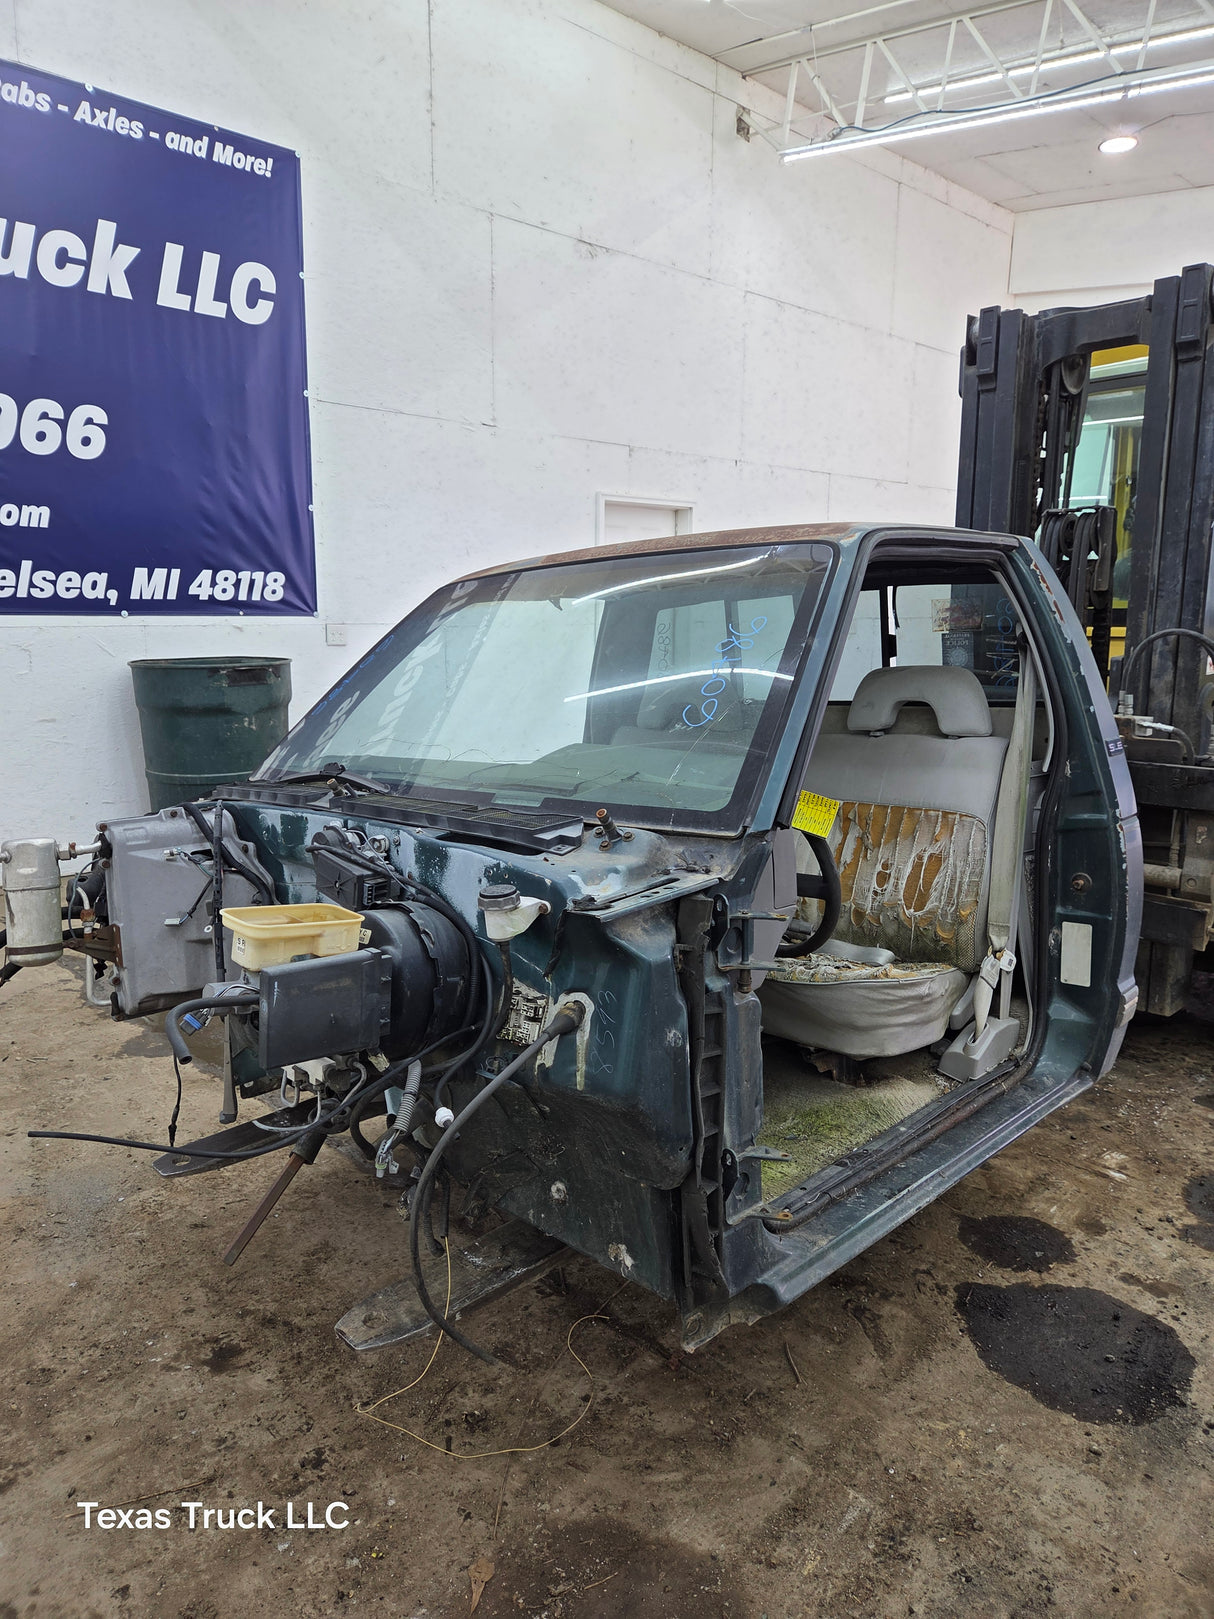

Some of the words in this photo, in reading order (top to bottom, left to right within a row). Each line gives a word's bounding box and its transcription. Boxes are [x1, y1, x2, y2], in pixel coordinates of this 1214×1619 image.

[0, 80, 51, 112] abs
[73, 101, 144, 139] Axles
[165, 129, 209, 158] and
[212, 141, 274, 178] More!
[156, 241, 277, 325] LLC
[130, 567, 181, 600] MI
[188, 569, 286, 602] 48118
